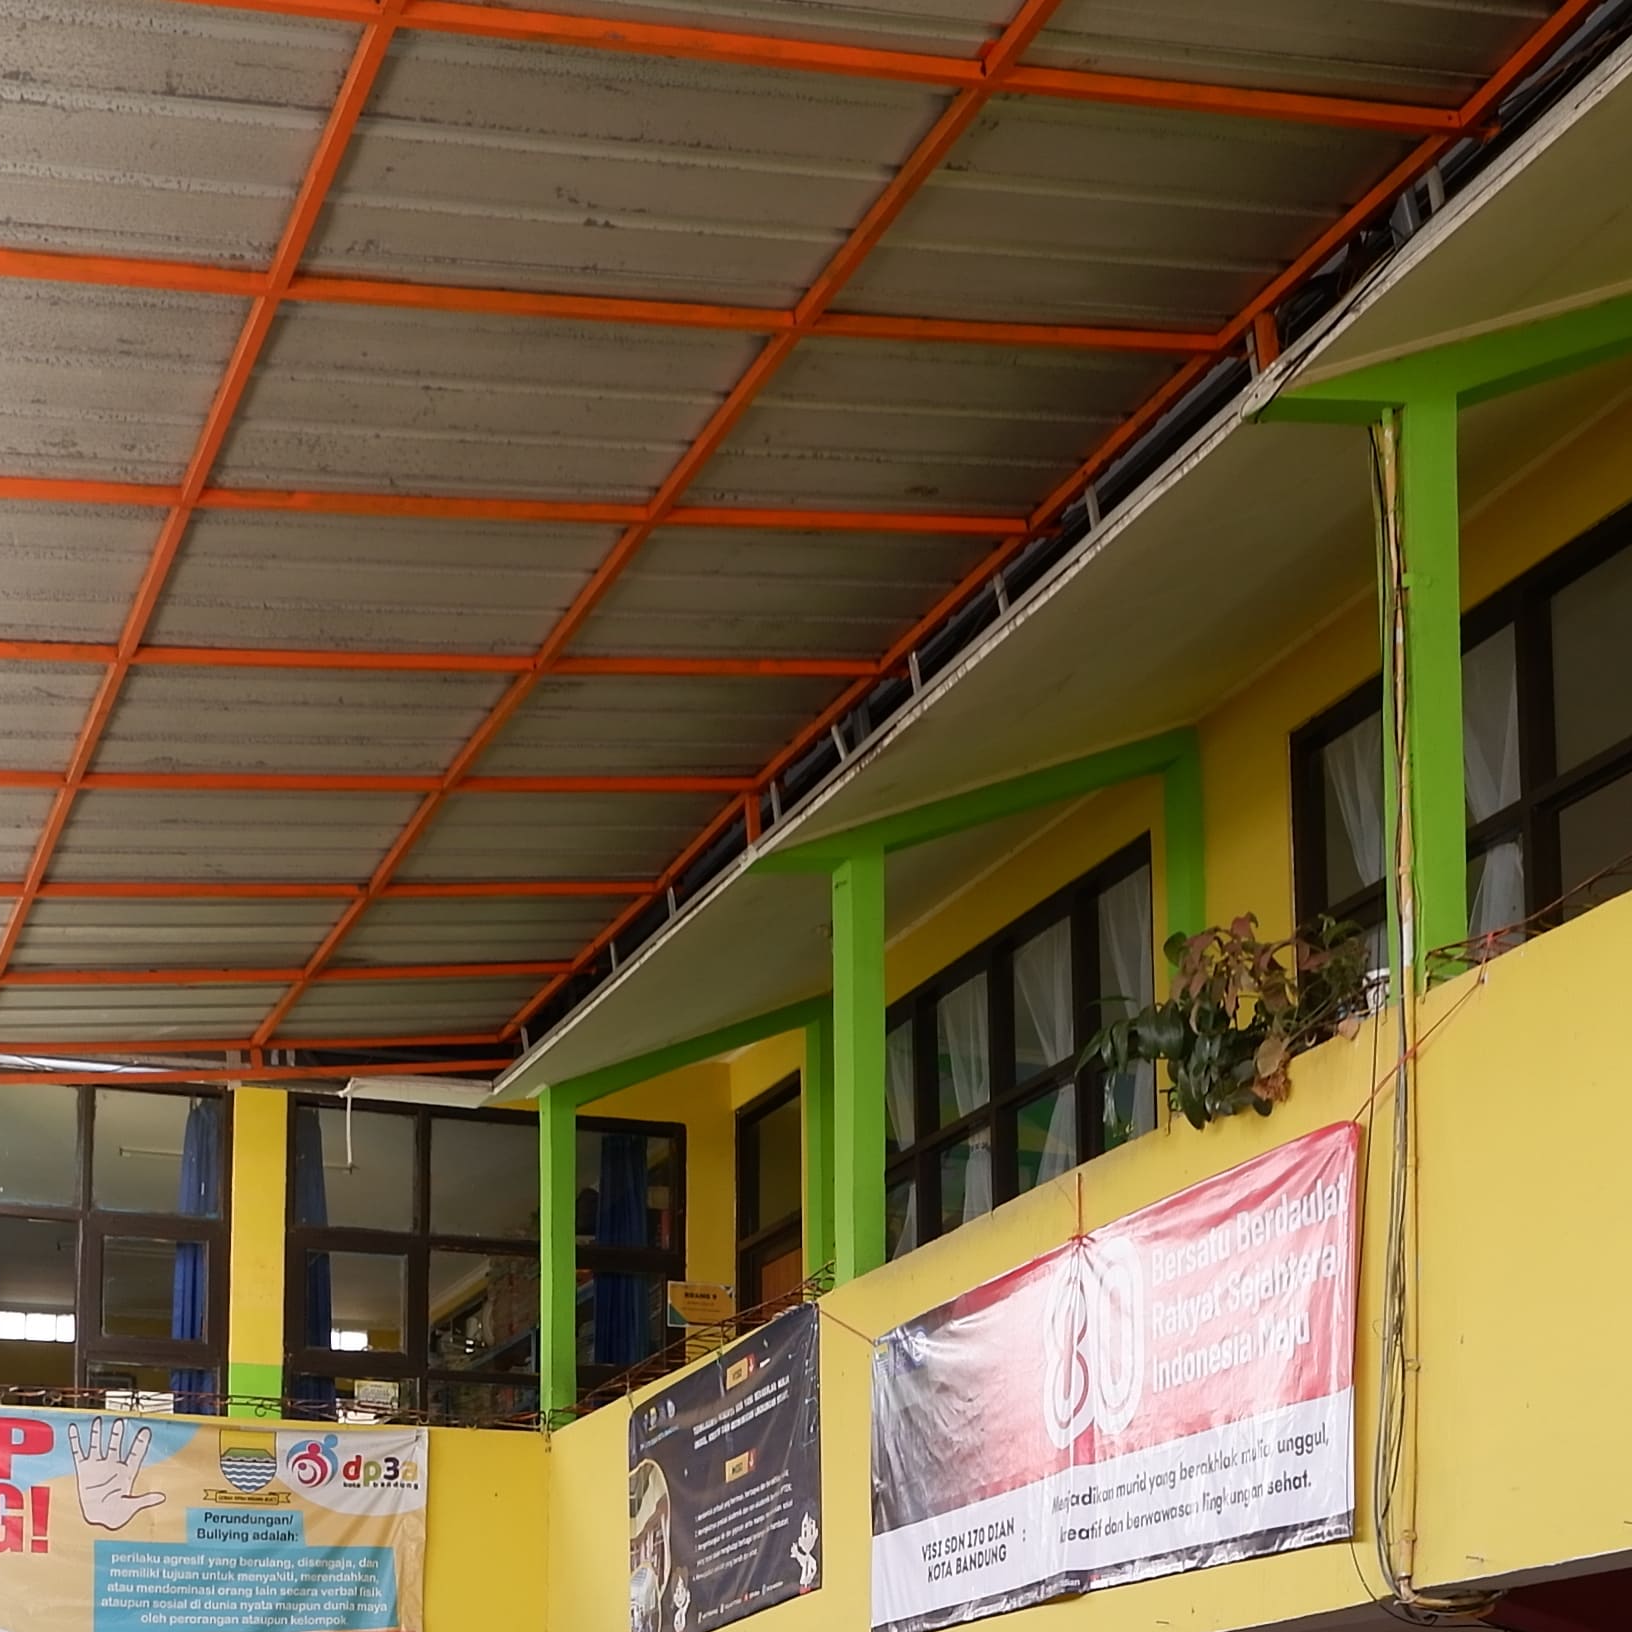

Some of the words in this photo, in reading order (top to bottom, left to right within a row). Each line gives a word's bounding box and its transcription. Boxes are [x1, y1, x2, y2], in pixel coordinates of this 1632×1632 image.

[1151, 1225, 1231, 1287] Bersatu
[1151, 1284, 1224, 1340] Rakyat
[1152, 1325, 1253, 1393] Indonesia
[1257, 1311, 1311, 1360] Maju
[341, 1454, 419, 1487] dp3a
[1115, 1473, 1147, 1498] murid
[1148, 1468, 1177, 1496] yang
[1179, 1450, 1239, 1482] berakhlak
[1276, 1422, 1330, 1458] unggul,
[1104, 1515, 1124, 1536] dan
[1267, 1468, 1313, 1497] sehat.
[196, 1527, 250, 1543] Bullying
[251, 1529, 299, 1542] adalah:
[921, 1539, 943, 1563] VISI
[944, 1532, 966, 1555] SDN
[967, 1525, 986, 1549] 170
[987, 1517, 1015, 1543] DIAN
[110, 1568, 160, 1579] memiliki
[162, 1569, 199, 1582] tujuan
[202, 1569, 235, 1581] untuk
[111, 1553, 161, 1566] perilaku
[163, 1553, 205, 1566] agresif
[208, 1557, 237, 1568] yang
[239, 1555, 294, 1569] berulang,
[358, 1557, 379, 1569] dan
[927, 1561, 953, 1583] KOTA
[955, 1543, 1008, 1575] BANDUNG
[101, 1597, 150, 1609] ataupun
[152, 1598, 188, 1609] sosial
[190, 1598, 202, 1609] di
[204, 1599, 237, 1610] dunia
[239, 1600, 273, 1613] nyata
[275, 1602, 321, 1614] maupun
[323, 1600, 355, 1612] dunia
[357, 1603, 388, 1614] maya
[107, 1582, 134, 1593] atau
[136, 1582, 215, 1595] mendominasi
[217, 1586, 253, 1598] orang
[255, 1585, 277, 1596] lain
[279, 1587, 318, 1597] secara
[320, 1586, 357, 1597] verbal
[141, 1613, 166, 1625] oleh
[168, 1615, 239, 1627] perorangan
[241, 1615, 288, 1627] ataupun
